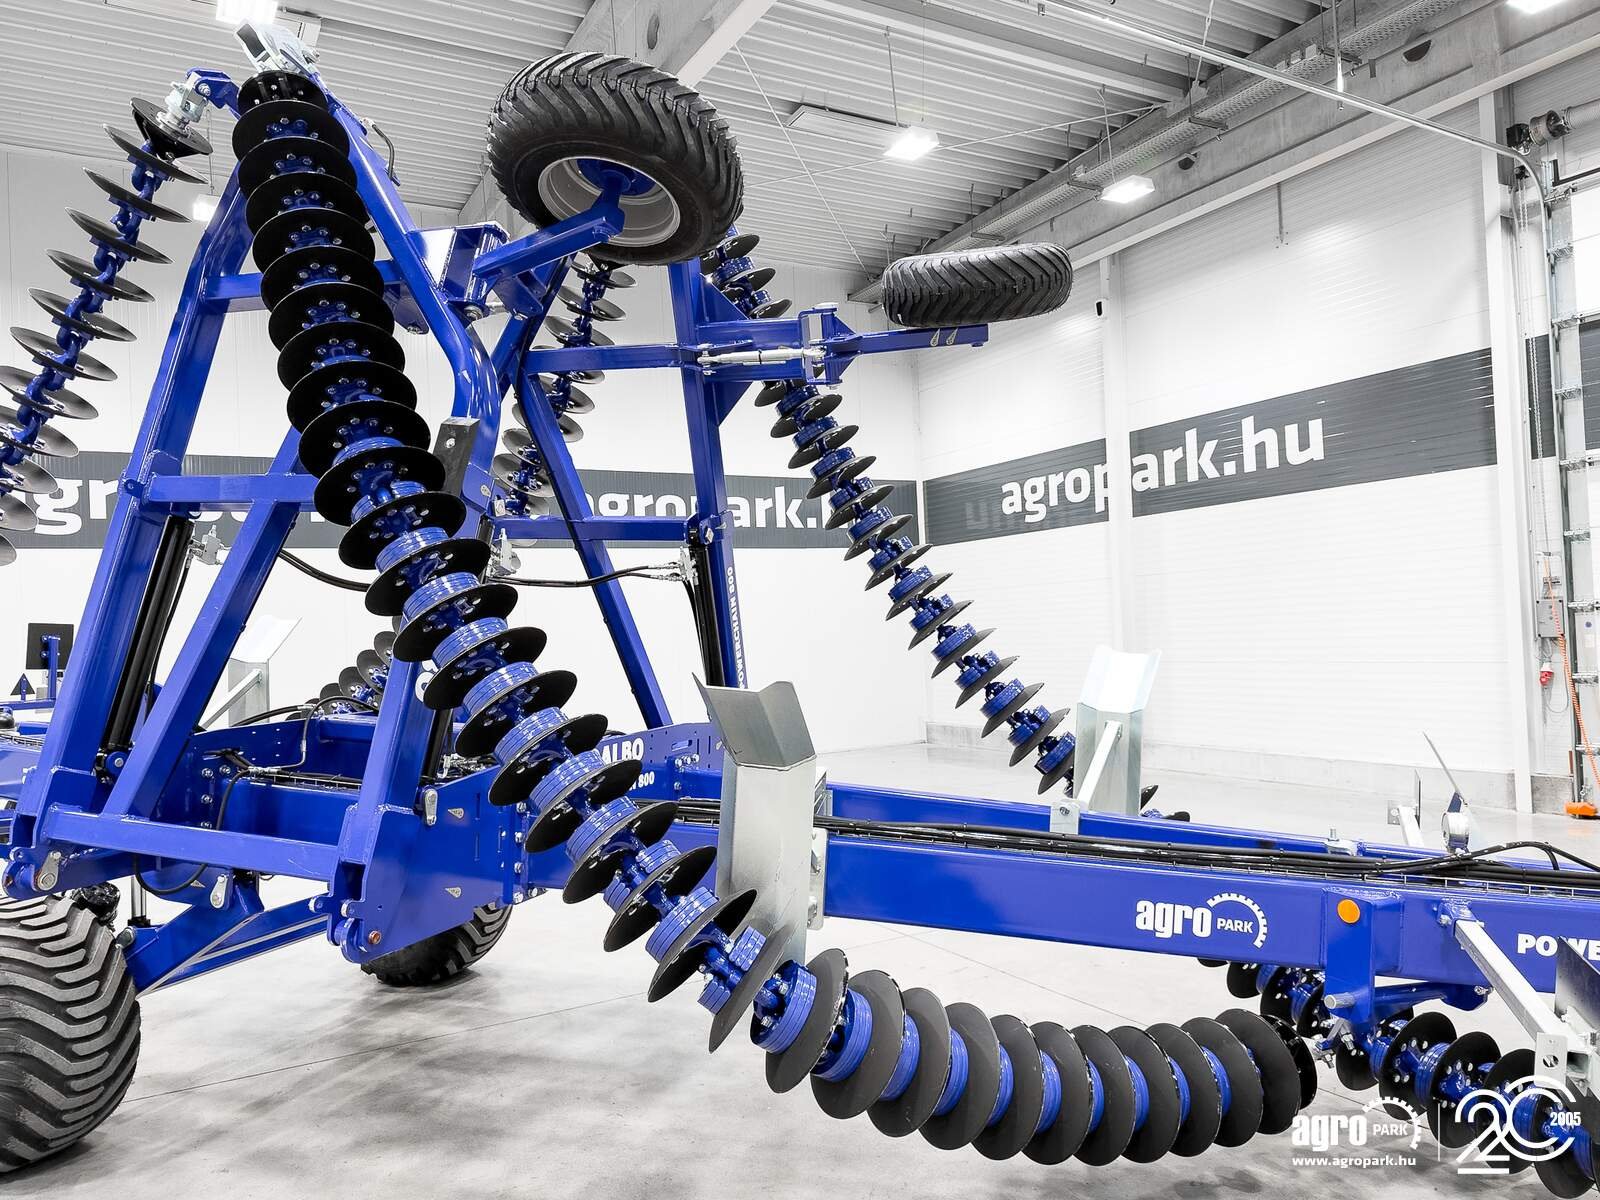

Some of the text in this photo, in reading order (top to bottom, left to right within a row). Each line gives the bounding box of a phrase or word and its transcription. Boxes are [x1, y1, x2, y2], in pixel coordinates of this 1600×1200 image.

[601, 737, 645, 763] ALBO
[638, 771, 655, 788] 800
[1135, 900, 1254, 938] agro PARK
